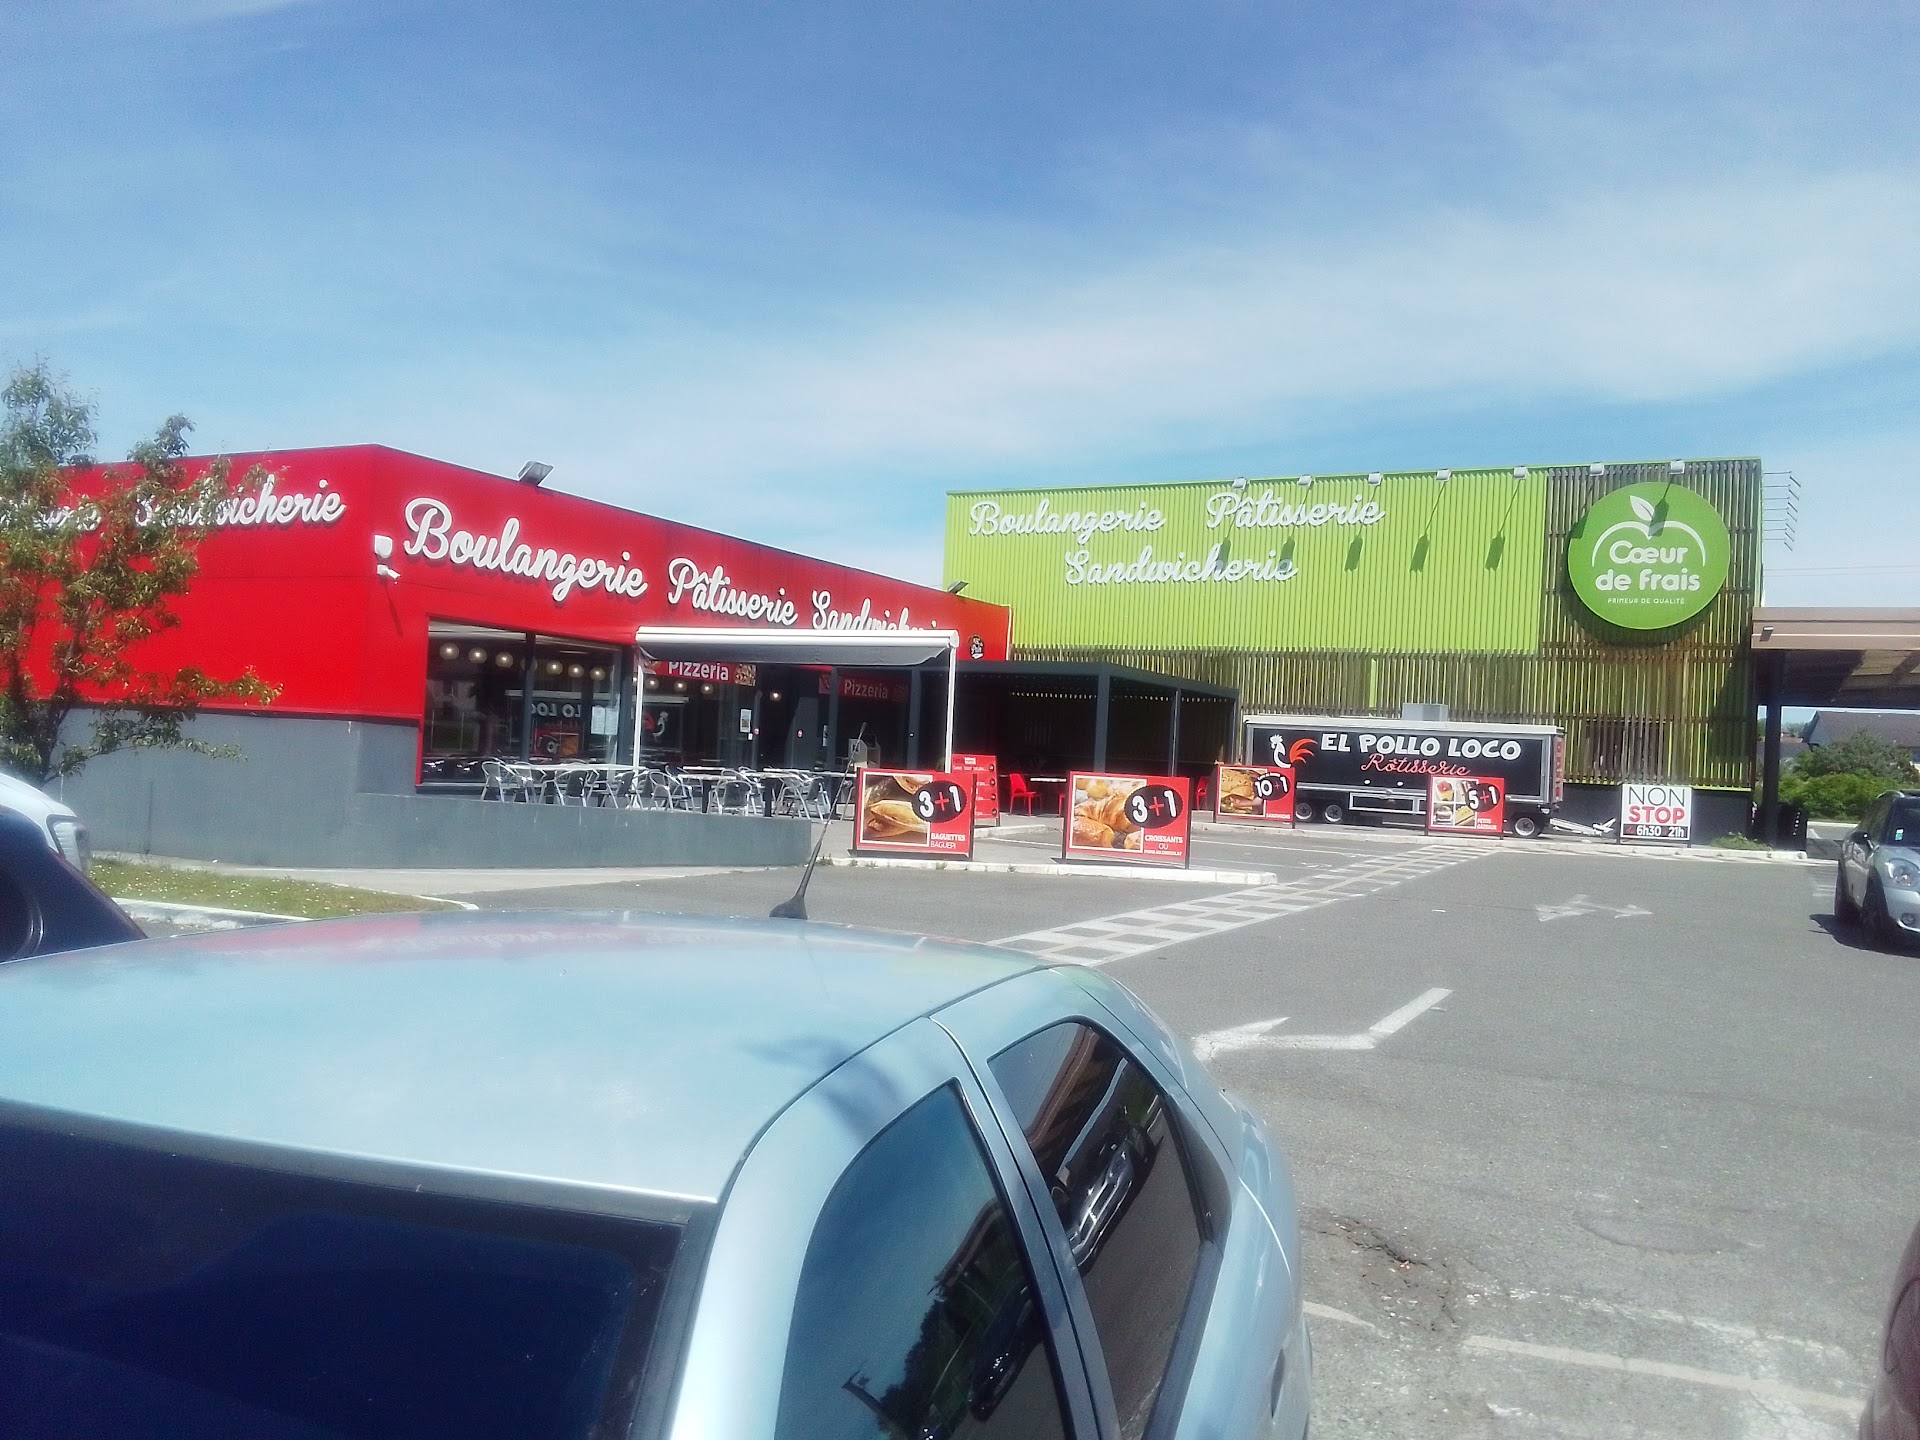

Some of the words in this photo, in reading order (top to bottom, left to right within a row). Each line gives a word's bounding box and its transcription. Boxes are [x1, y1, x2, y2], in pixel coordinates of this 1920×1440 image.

[968, 498, 1166, 545] Boulangerie
[1206, 489, 1386, 529] Pâtisserie
[403, 498, 648, 602] Boulangerie
[668, 557, 798, 627] Pâtisserie
[1609, 540, 1689, 564] Cœur
[1064, 543, 1298, 586] Sandwicherie
[1595, 568, 1632, 591] de
[1639, 567, 1700, 591] frais
[1607, 597, 1638, 605] PRIMEUR
[1641, 597, 1650, 605] DE
[1653, 596, 1685, 605] QUALITÉ
[668, 661, 730, 682] Pizzeria
[844, 678, 889, 699] Pizzeria
[1320, 732, 1350, 752] EL
[1358, 733, 1440, 757] POLLO
[1447, 738, 1522, 761] LOCO
[1360, 752, 1471, 776] Rôtisserie
[918, 785, 961, 818] 3+1
[1132, 790, 1177, 823] 3+1
[1468, 786, 1498, 809] 5+1
[1628, 786, 1685, 807] NON
[1628, 805, 1685, 824] STOP
[930, 832, 966, 842] BAGUETTES
[1144, 834, 1183, 844] CROISSANTS
[1636, 824, 1662, 836] 6h30
[1668, 826, 1685, 838] 21h
